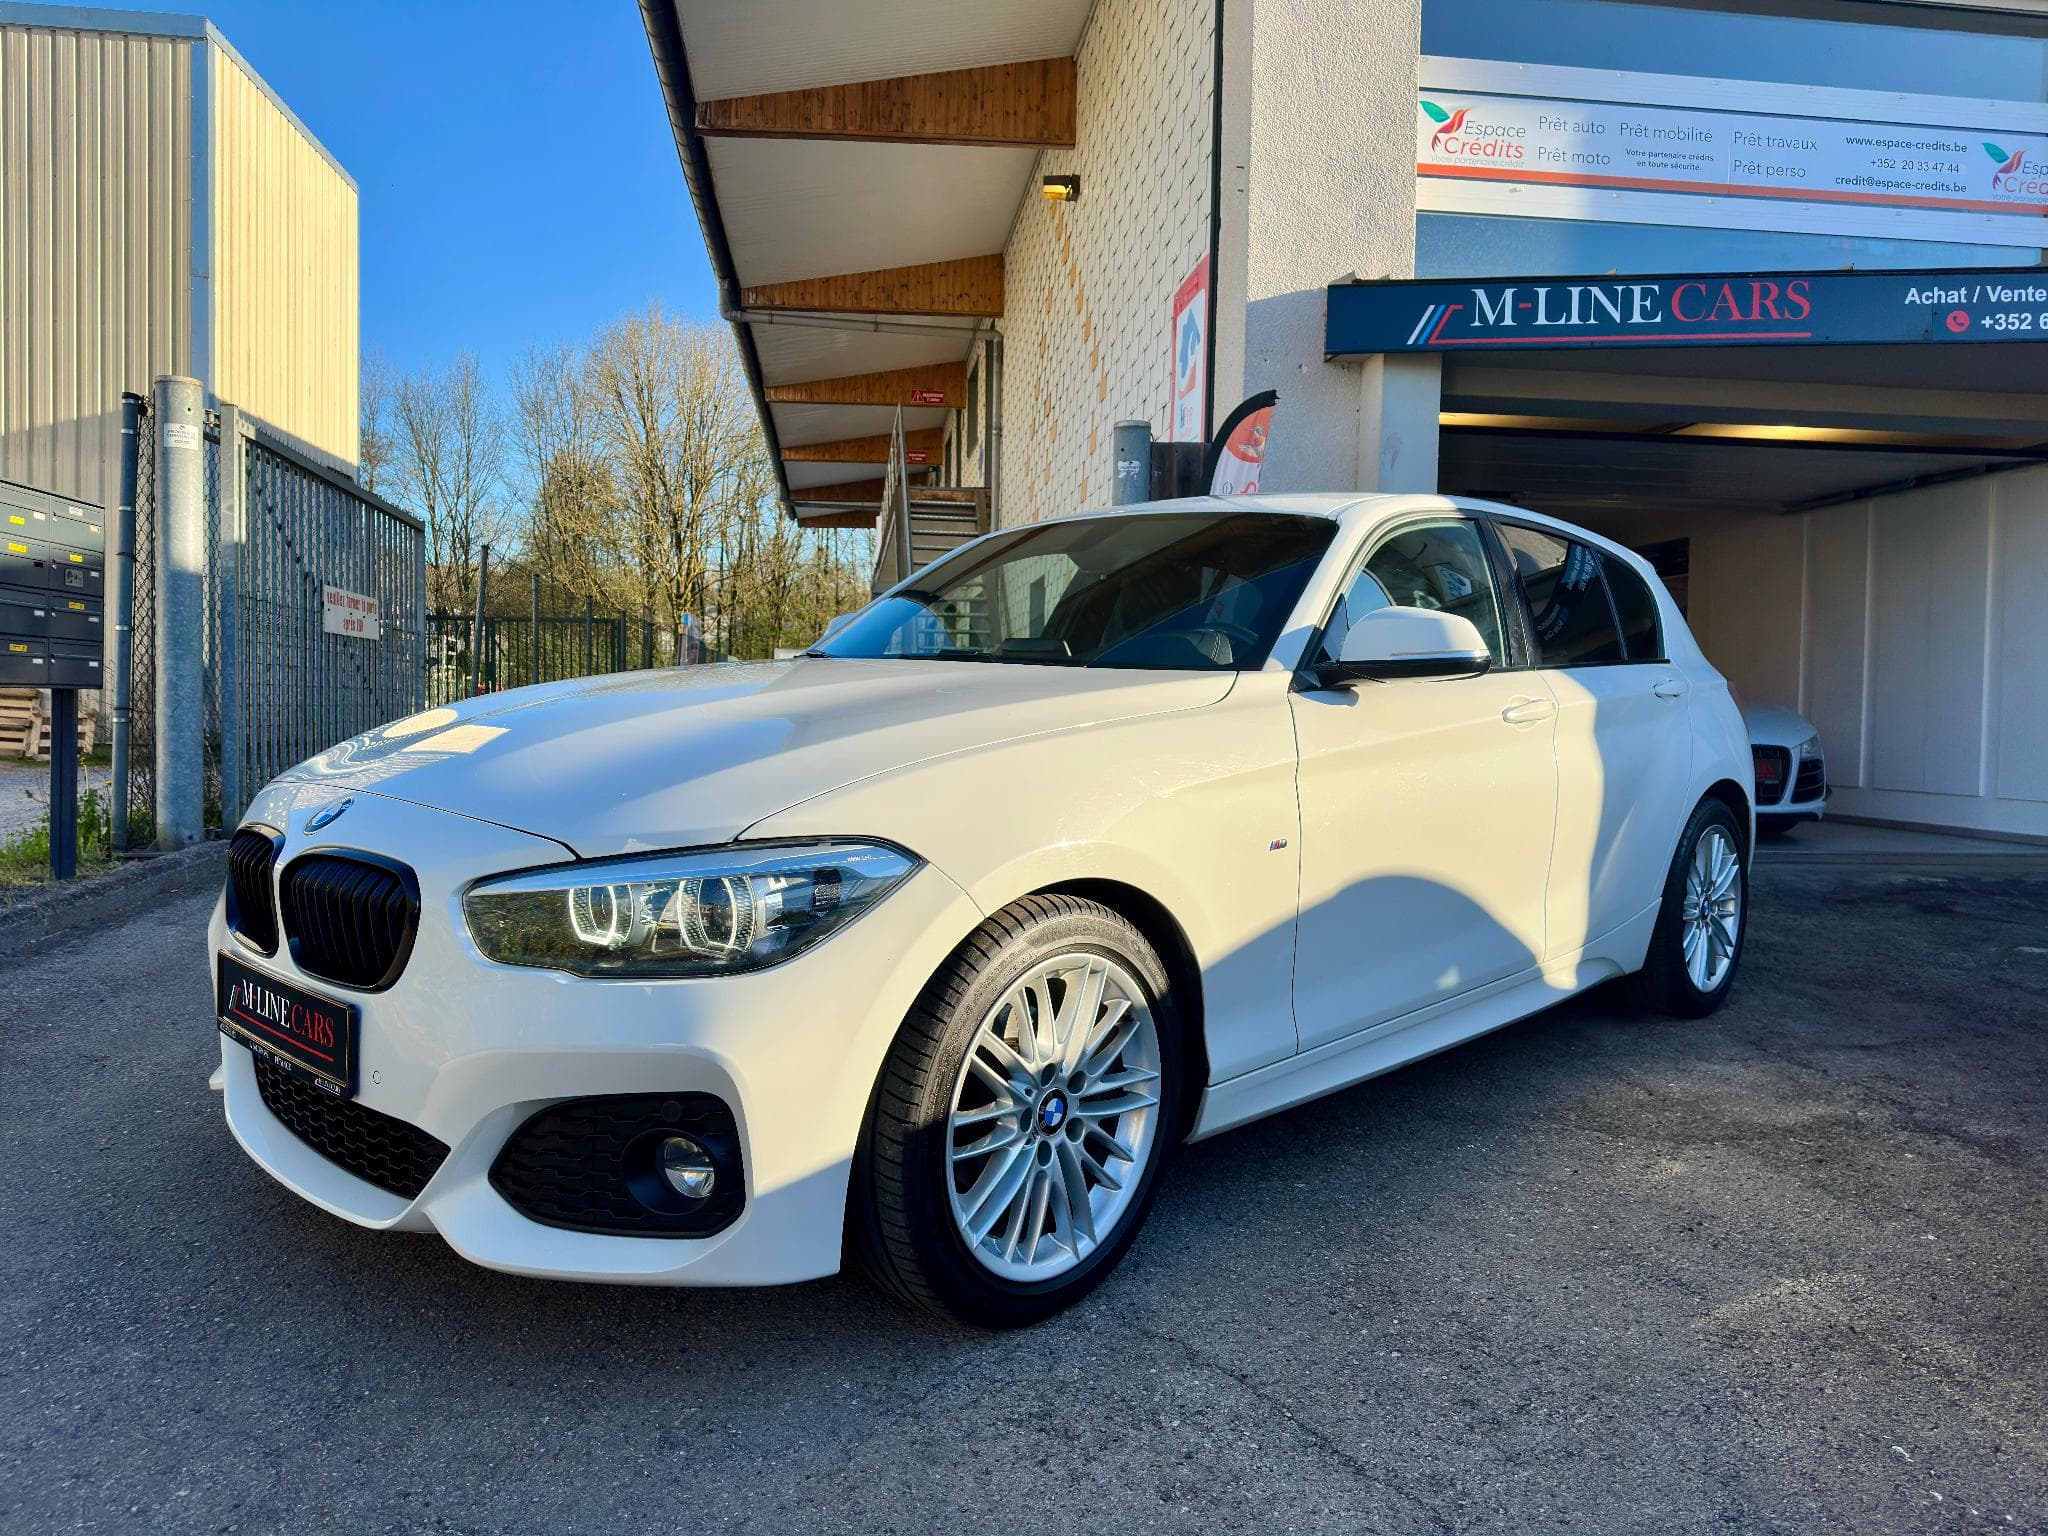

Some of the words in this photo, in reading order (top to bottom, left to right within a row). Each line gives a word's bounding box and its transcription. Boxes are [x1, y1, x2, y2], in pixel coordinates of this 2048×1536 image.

[1465, 120, 1526, 139] Espace
[1539, 116, 1568, 132] Prêt
[1572, 119, 1605, 135] auto
[1620, 122, 1649, 138] Prêt
[1653, 125, 1713, 143] mobilité
[1444, 136, 1525, 159] Crédits
[1734, 131, 1762, 147] Prêt
[1767, 135, 1818, 150] travaux
[1846, 136, 1968, 153] www.espace-credits.be
[1432, 154, 1453, 163] Votre
[1454, 157, 1497, 168] partenaire
[1500, 159, 1524, 168] crédit
[1538, 146, 1567, 162] Prêt
[1572, 152, 1611, 166] moto
[1626, 148, 1647, 157] Votre
[1648, 151, 1687, 160] partenaire
[1688, 153, 1714, 161] crédits
[1648, 161, 1669, 169] toute
[1734, 159, 1762, 176] Prêt
[1766, 165, 1806, 179] perso
[1870, 158, 1896, 169] +352
[1902, 159, 1914, 170] 20
[1917, 161, 1929, 172] 33
[1932, 162, 1945, 173] 47
[1947, 163, 1960, 174] 44
[1835, 176, 1967, 193] credit@espace-credits.be
[1470, 284, 1662, 327] M-LINE
[1670, 280, 1812, 323] CARS
[1904, 286, 1968, 305] Achat
[1972, 285, 1981, 303] /
[1986, 285, 2047, 303] Vente
[1981, 312, 2032, 331] +352
[241, 978, 291, 1028] M-LINE
[291, 1003, 335, 1048] CARS
